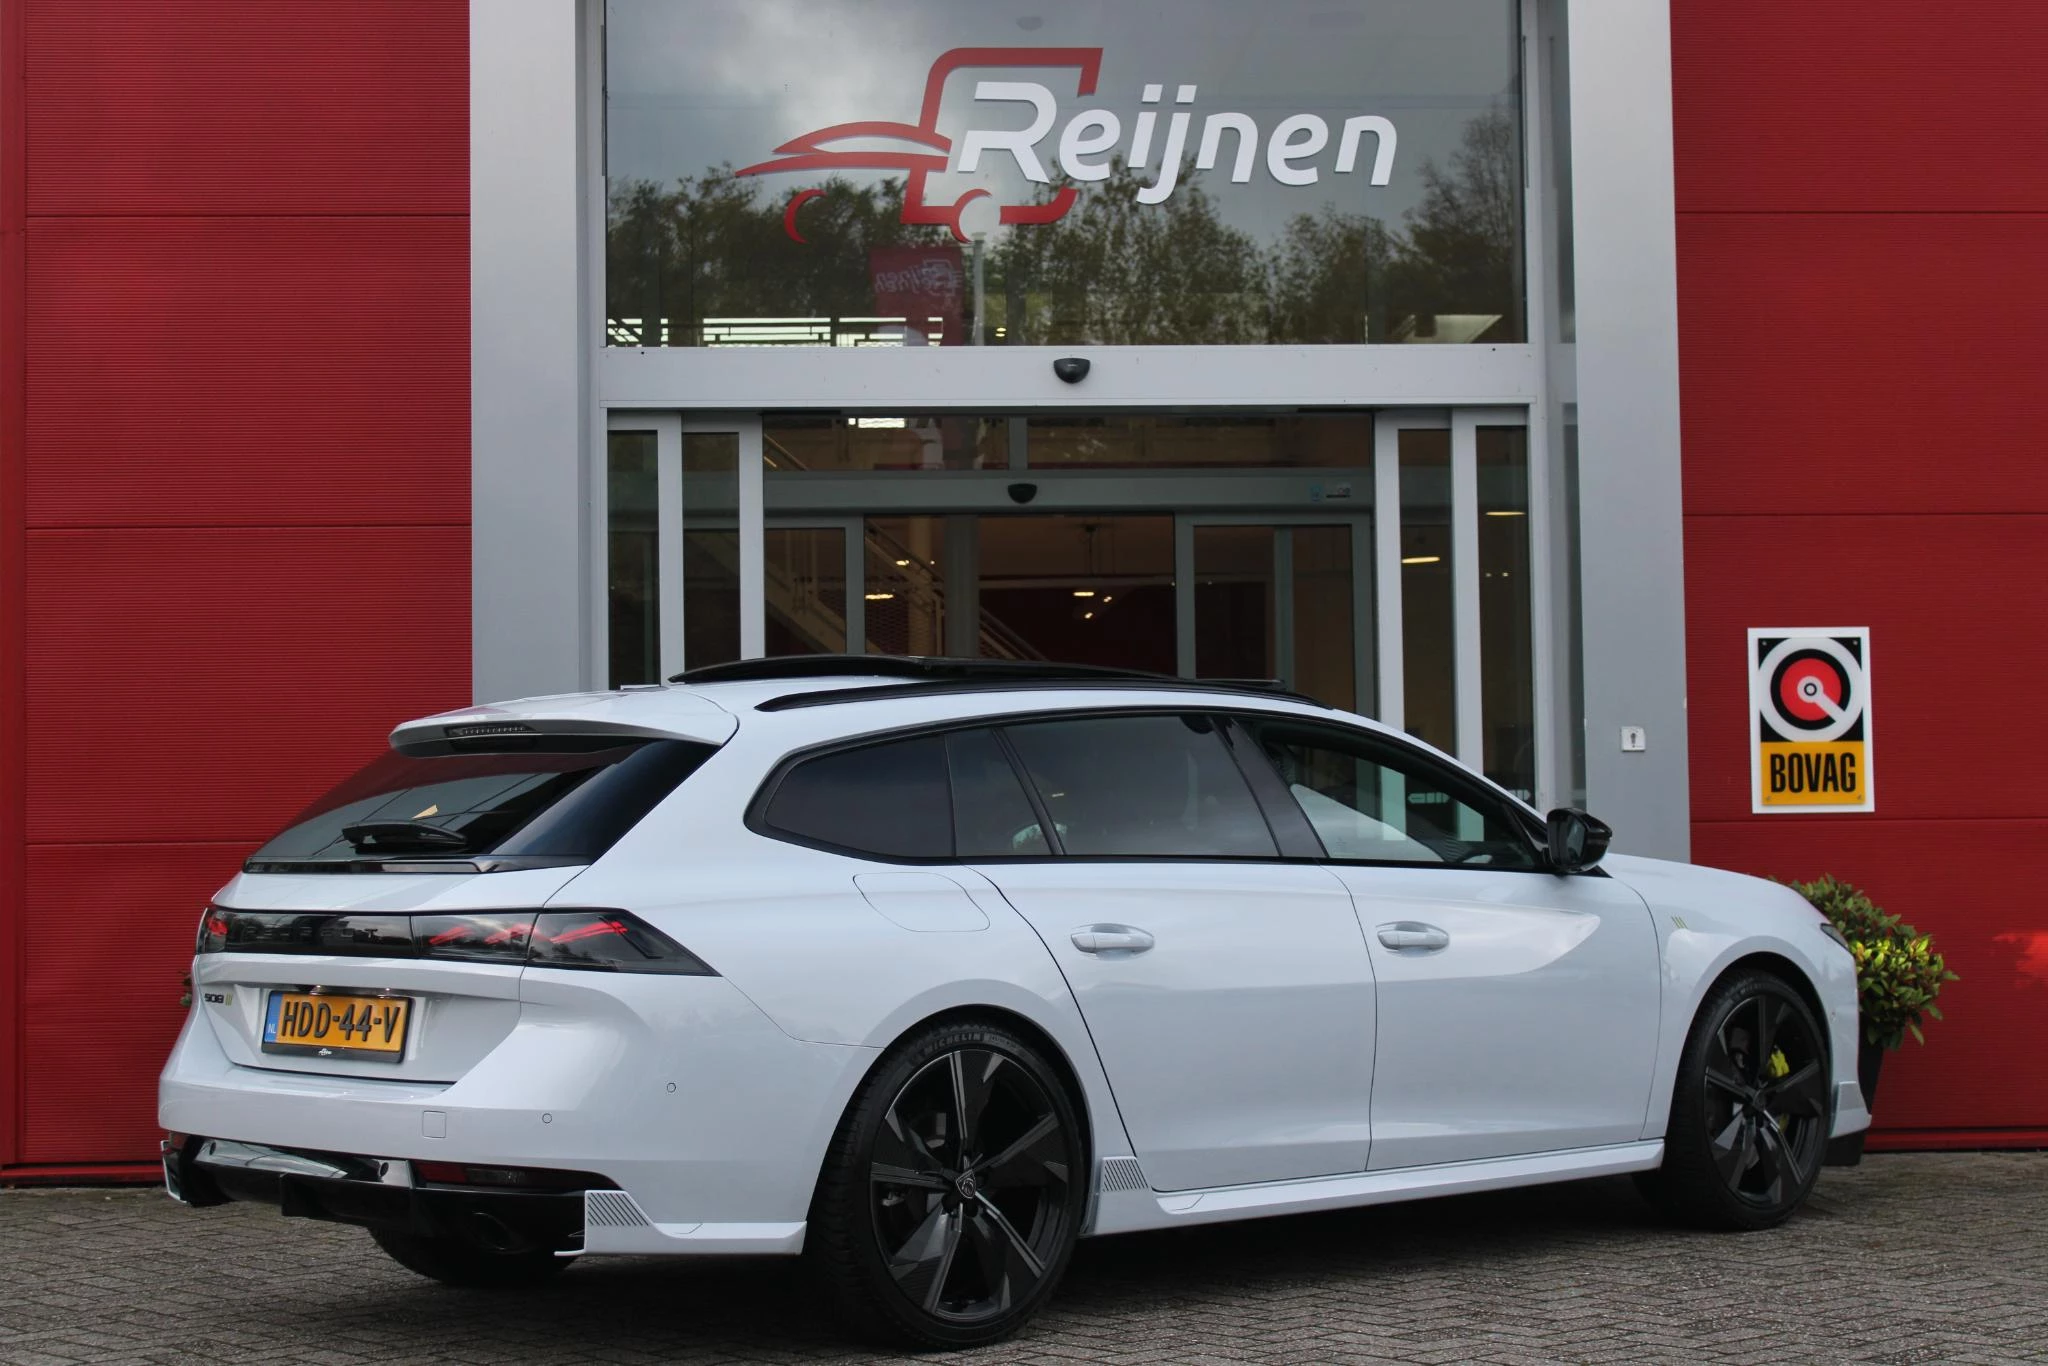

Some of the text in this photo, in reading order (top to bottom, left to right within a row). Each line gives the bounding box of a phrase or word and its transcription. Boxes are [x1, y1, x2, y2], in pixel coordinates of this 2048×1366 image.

[957, 82, 1398, 206] Reijnen
[1770, 753, 1856, 793] BOVAG
[204, 993, 225, 1004] 508
[267, 1023, 277, 1034] NL
[281, 1001, 400, 1043] HDD-44-V
